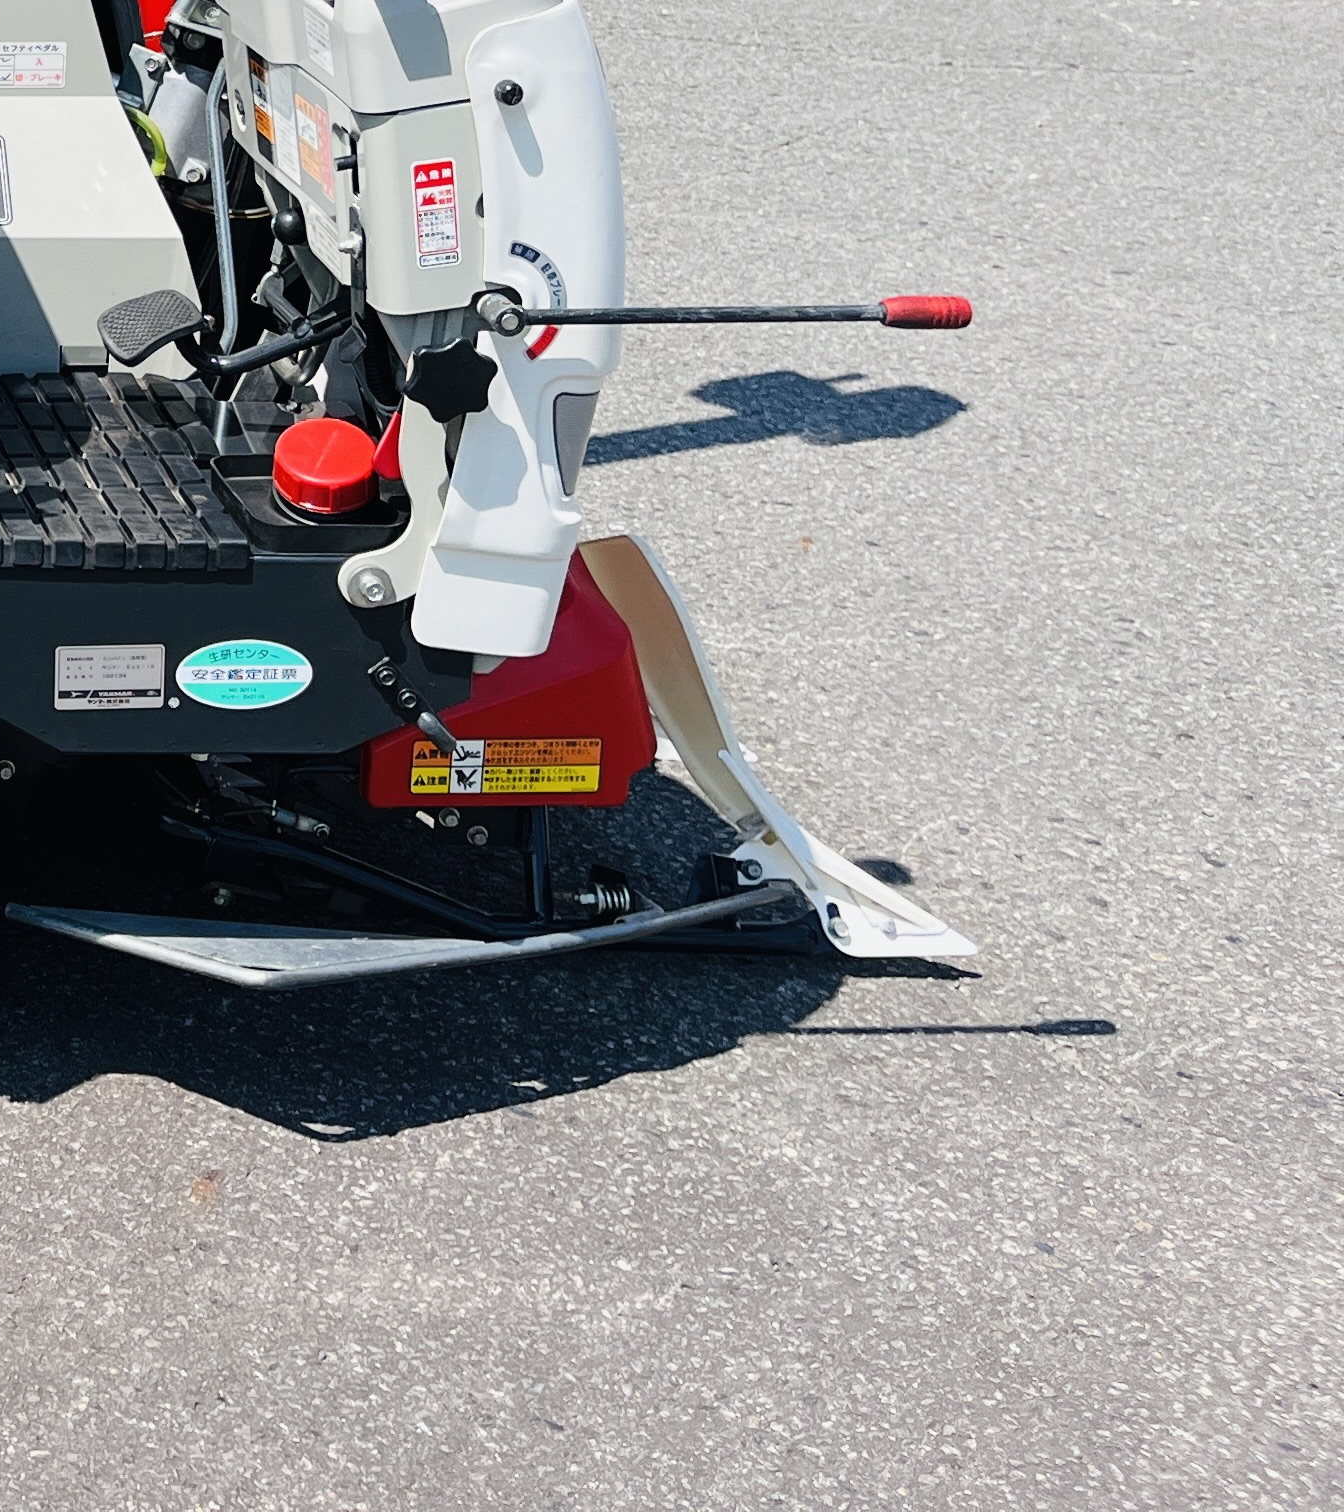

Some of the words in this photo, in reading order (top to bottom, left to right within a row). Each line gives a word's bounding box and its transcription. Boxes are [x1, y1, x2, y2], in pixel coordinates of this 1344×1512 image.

[2, 44, 60, 52] セフティペダル
[540, 262, 562, 307] 駐車ブレー
[208, 648, 280, 664] 生研センター
[192, 668, 297, 680] 安全鑑定証票
[427, 775, 447, 785] 注意
